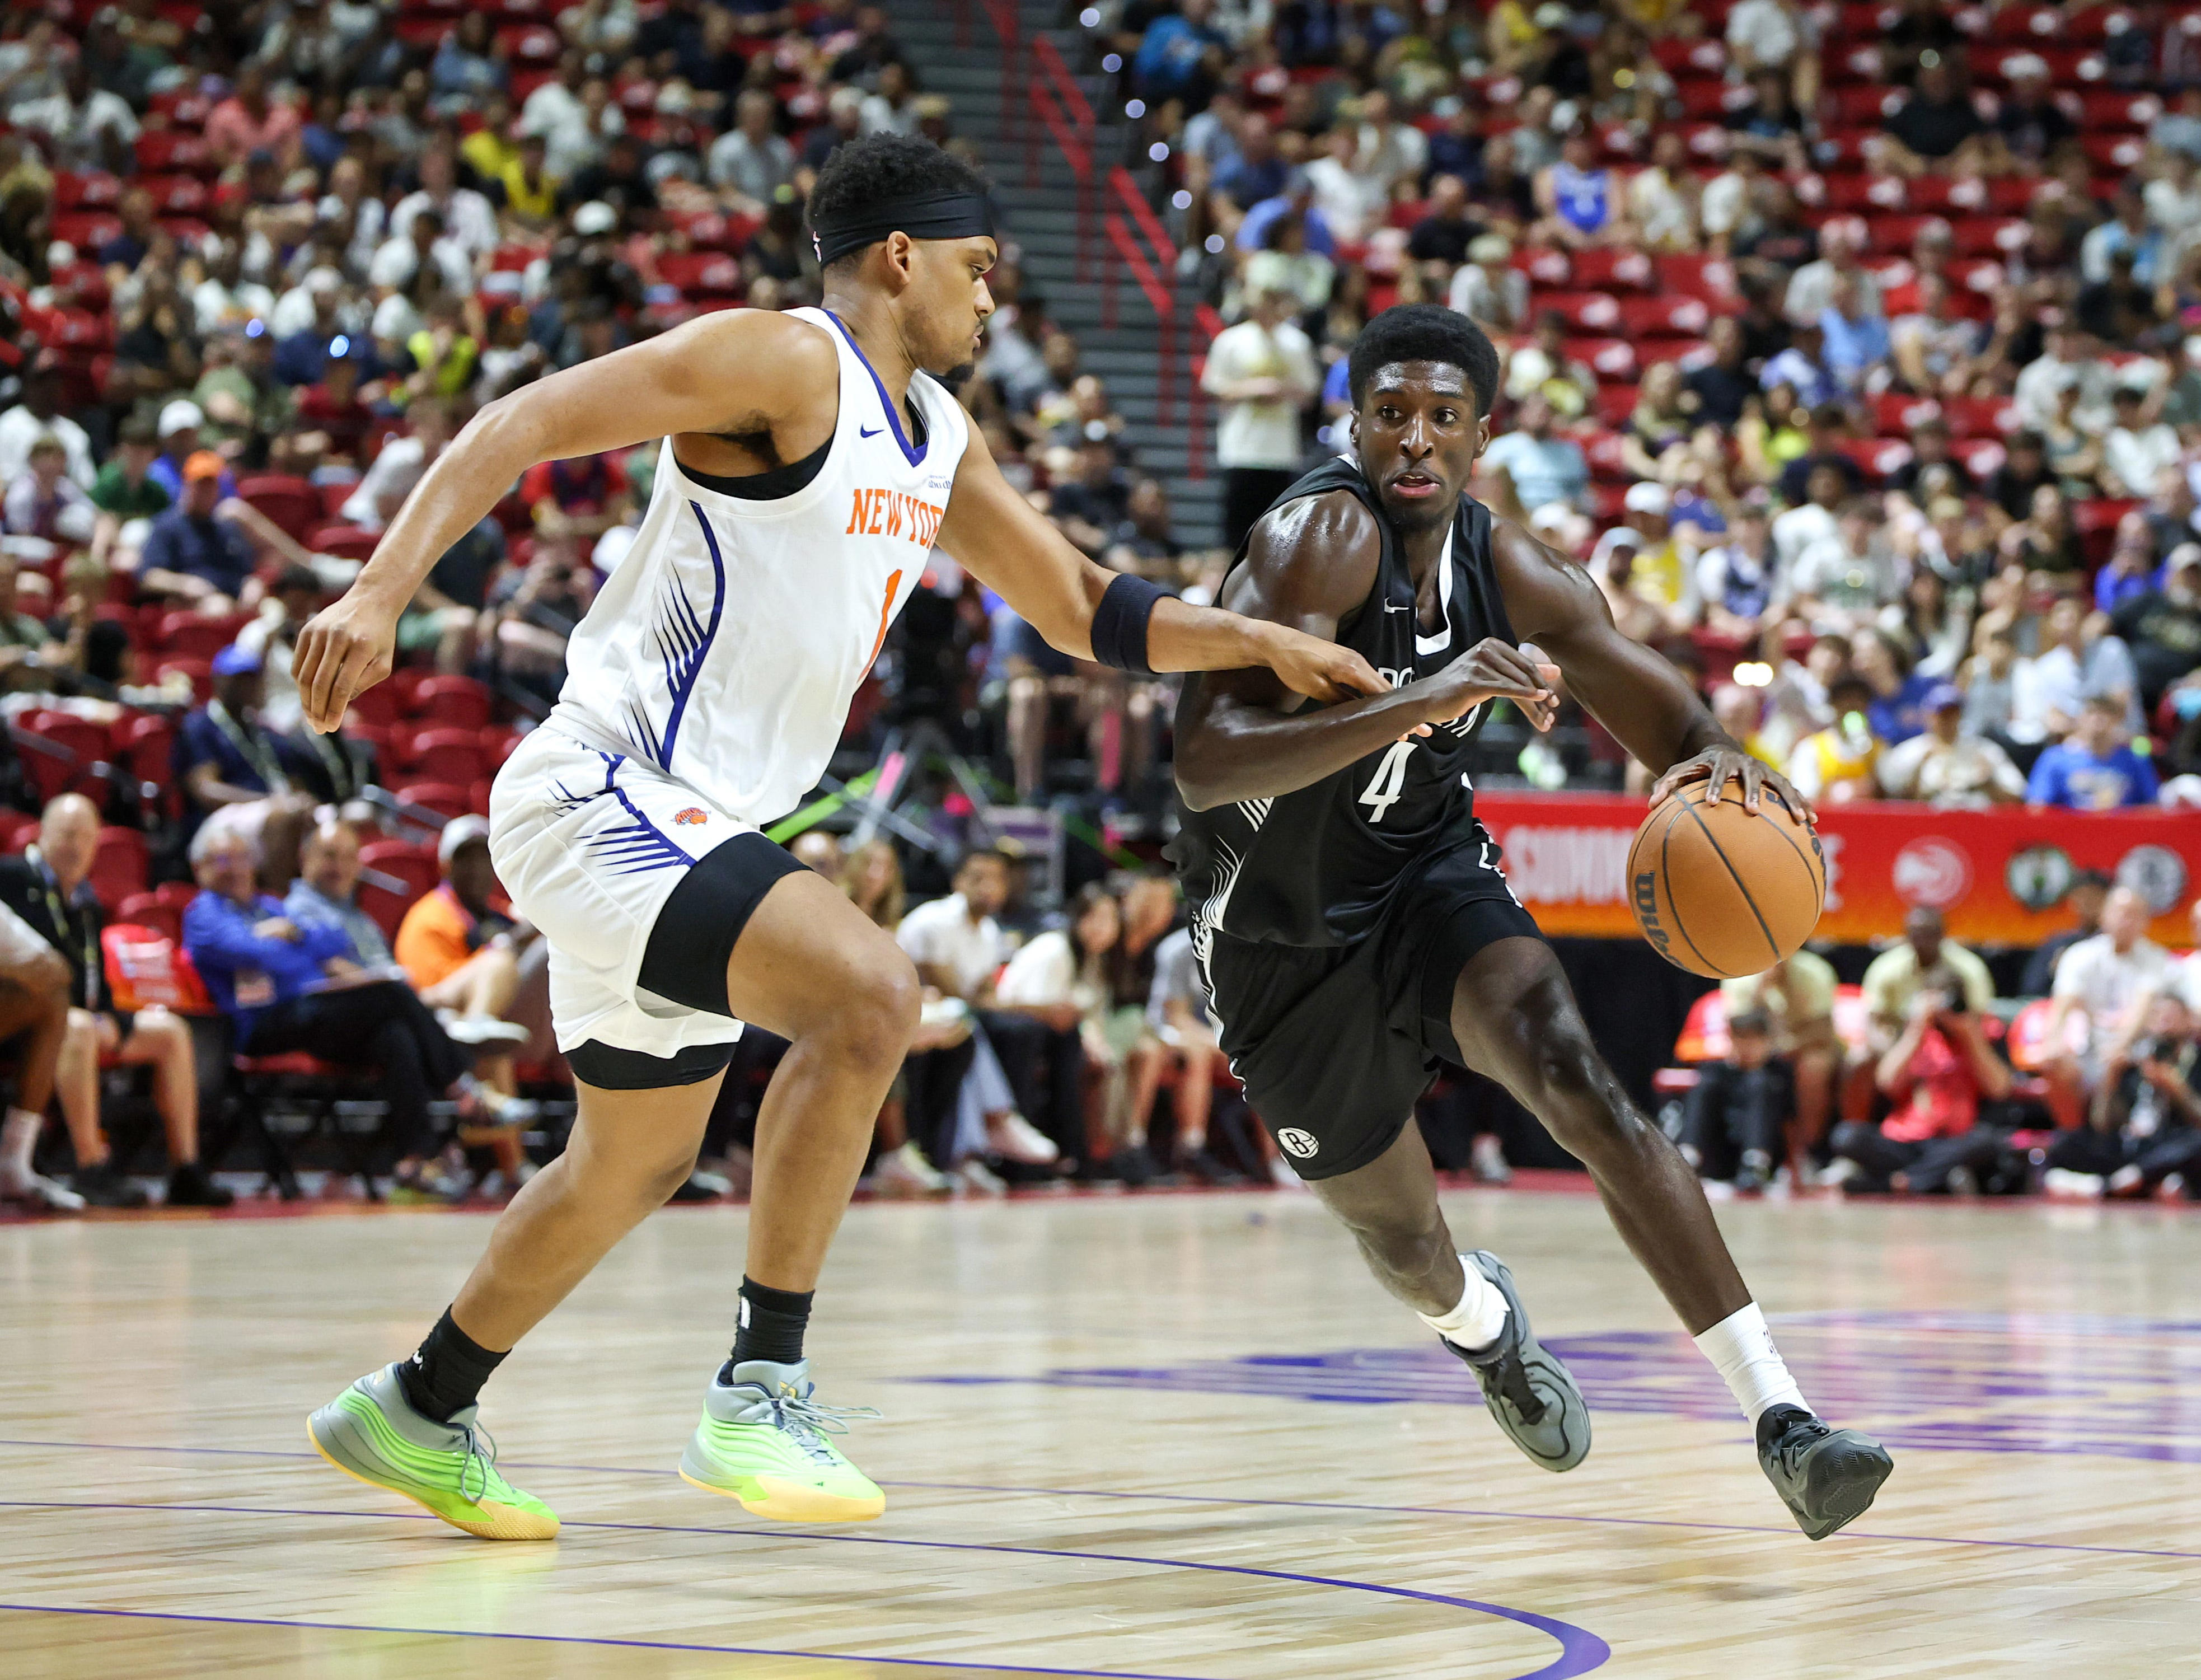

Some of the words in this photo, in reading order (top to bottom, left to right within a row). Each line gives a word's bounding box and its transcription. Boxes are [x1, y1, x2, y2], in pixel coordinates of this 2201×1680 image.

[846, 489, 903, 536] NEW
[906, 495, 944, 549] YOR
[856, 569, 903, 684] 1
[1358, 741, 1418, 823] 4
[1502, 825, 1633, 907] SUMM
[1285, 1133, 1310, 1154] B
